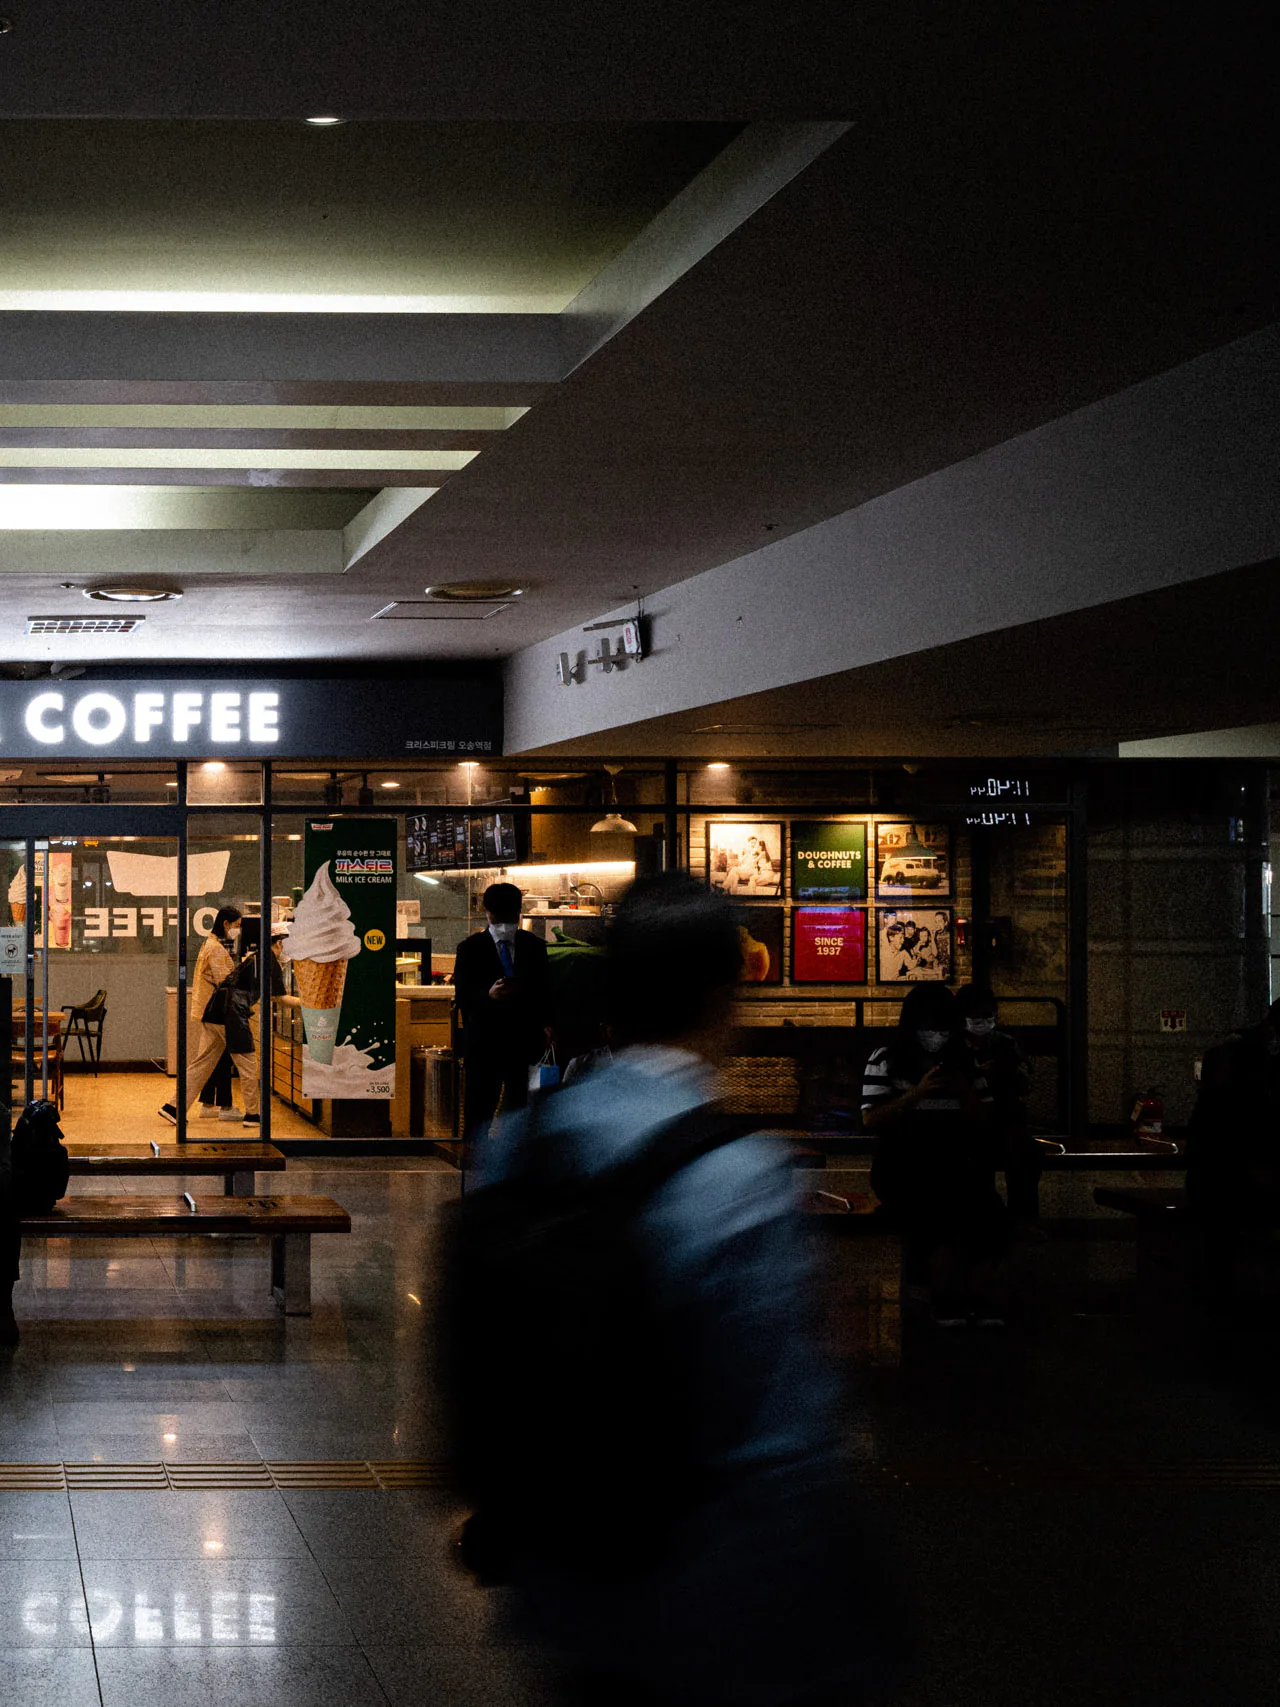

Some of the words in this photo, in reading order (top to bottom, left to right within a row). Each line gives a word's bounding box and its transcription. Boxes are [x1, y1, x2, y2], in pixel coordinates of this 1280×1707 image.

[24, 692, 279, 744] COFFEE
[797, 850, 861, 860] DOUGHNUTS
[807, 860, 815, 869] &
[817, 860, 852, 869] COFFEE
[354, 875, 367, 884] ICE
[367, 875, 392, 884] CREAM
[366, 935, 383, 945] NEW
[814, 937, 844, 947] SINCE
[816, 946, 841, 956] 1937
